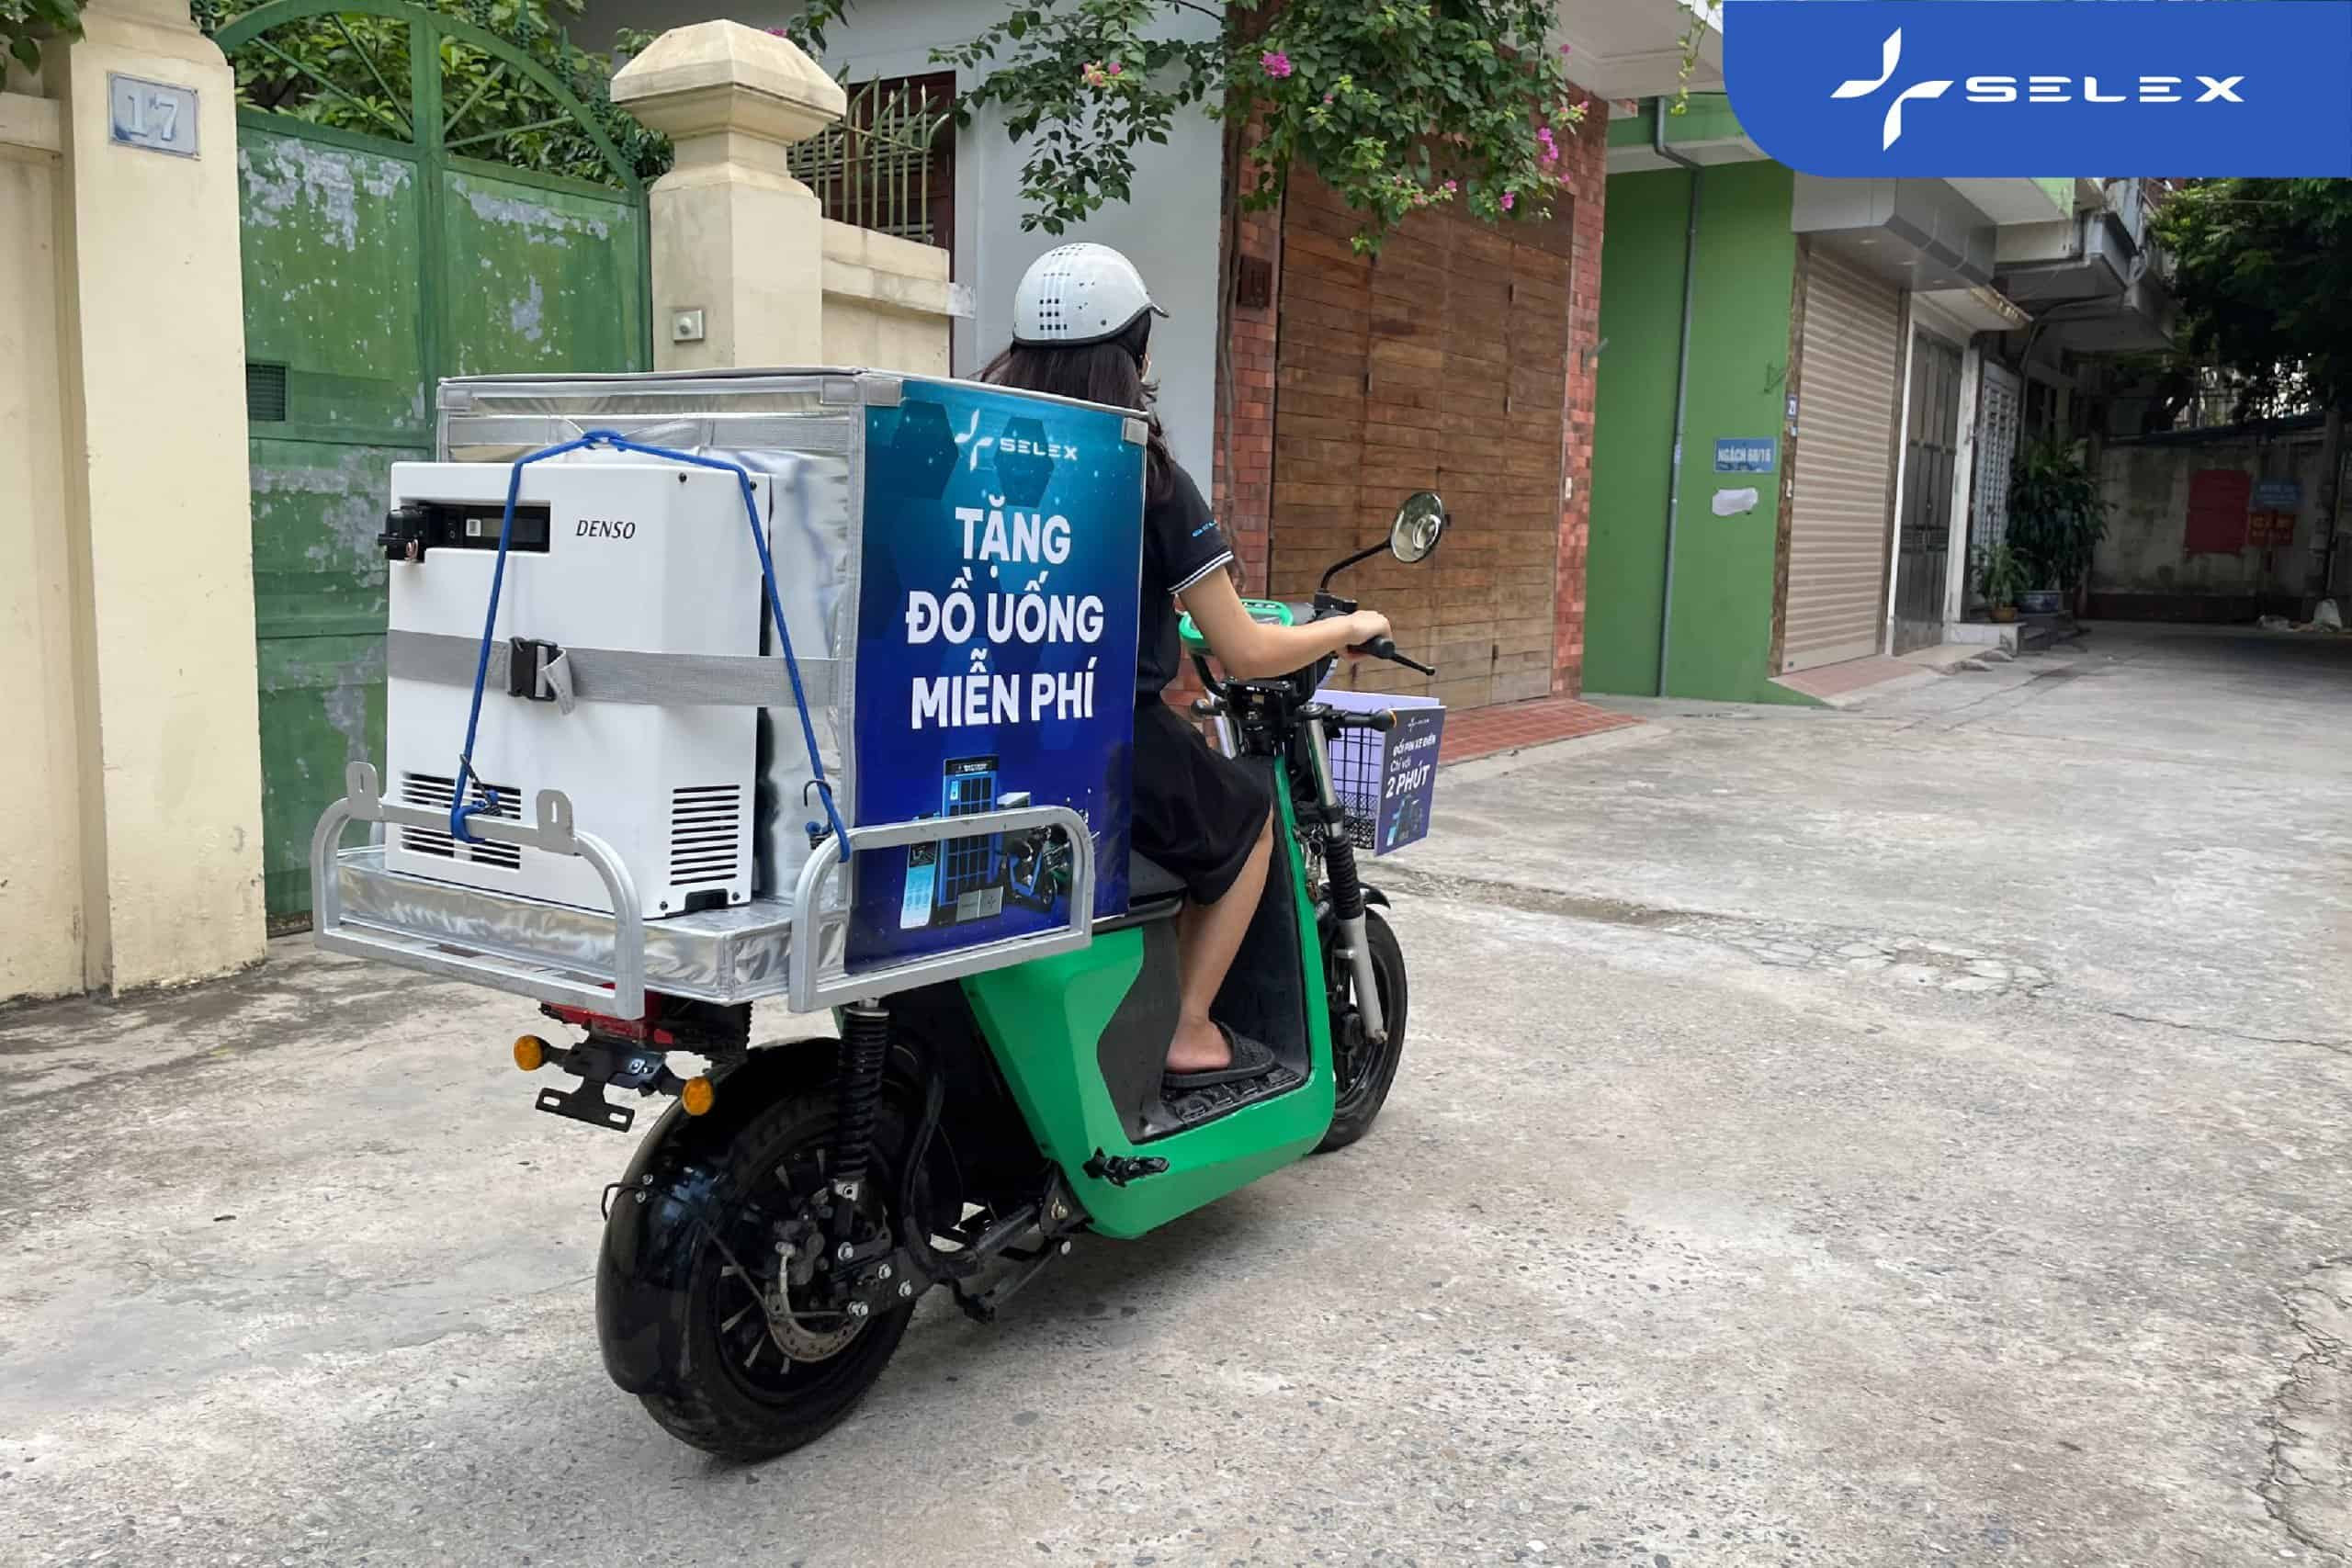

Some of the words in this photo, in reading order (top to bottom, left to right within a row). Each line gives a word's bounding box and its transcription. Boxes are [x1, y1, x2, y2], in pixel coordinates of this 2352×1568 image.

[127, 93, 178, 141] 17
[1000, 437, 1079, 461] SELEX
[575, 520, 636, 539] DENSO
[955, 493, 1071, 579] TẶNG
[906, 566, 976, 644] ĐỒ
[987, 570, 1104, 644] UỐNG
[911, 648, 1020, 729] MIỄN
[1031, 656, 1097, 721] PHÍ
[1385, 776, 1396, 798] 2
[1396, 760, 1430, 795] PHÚT
